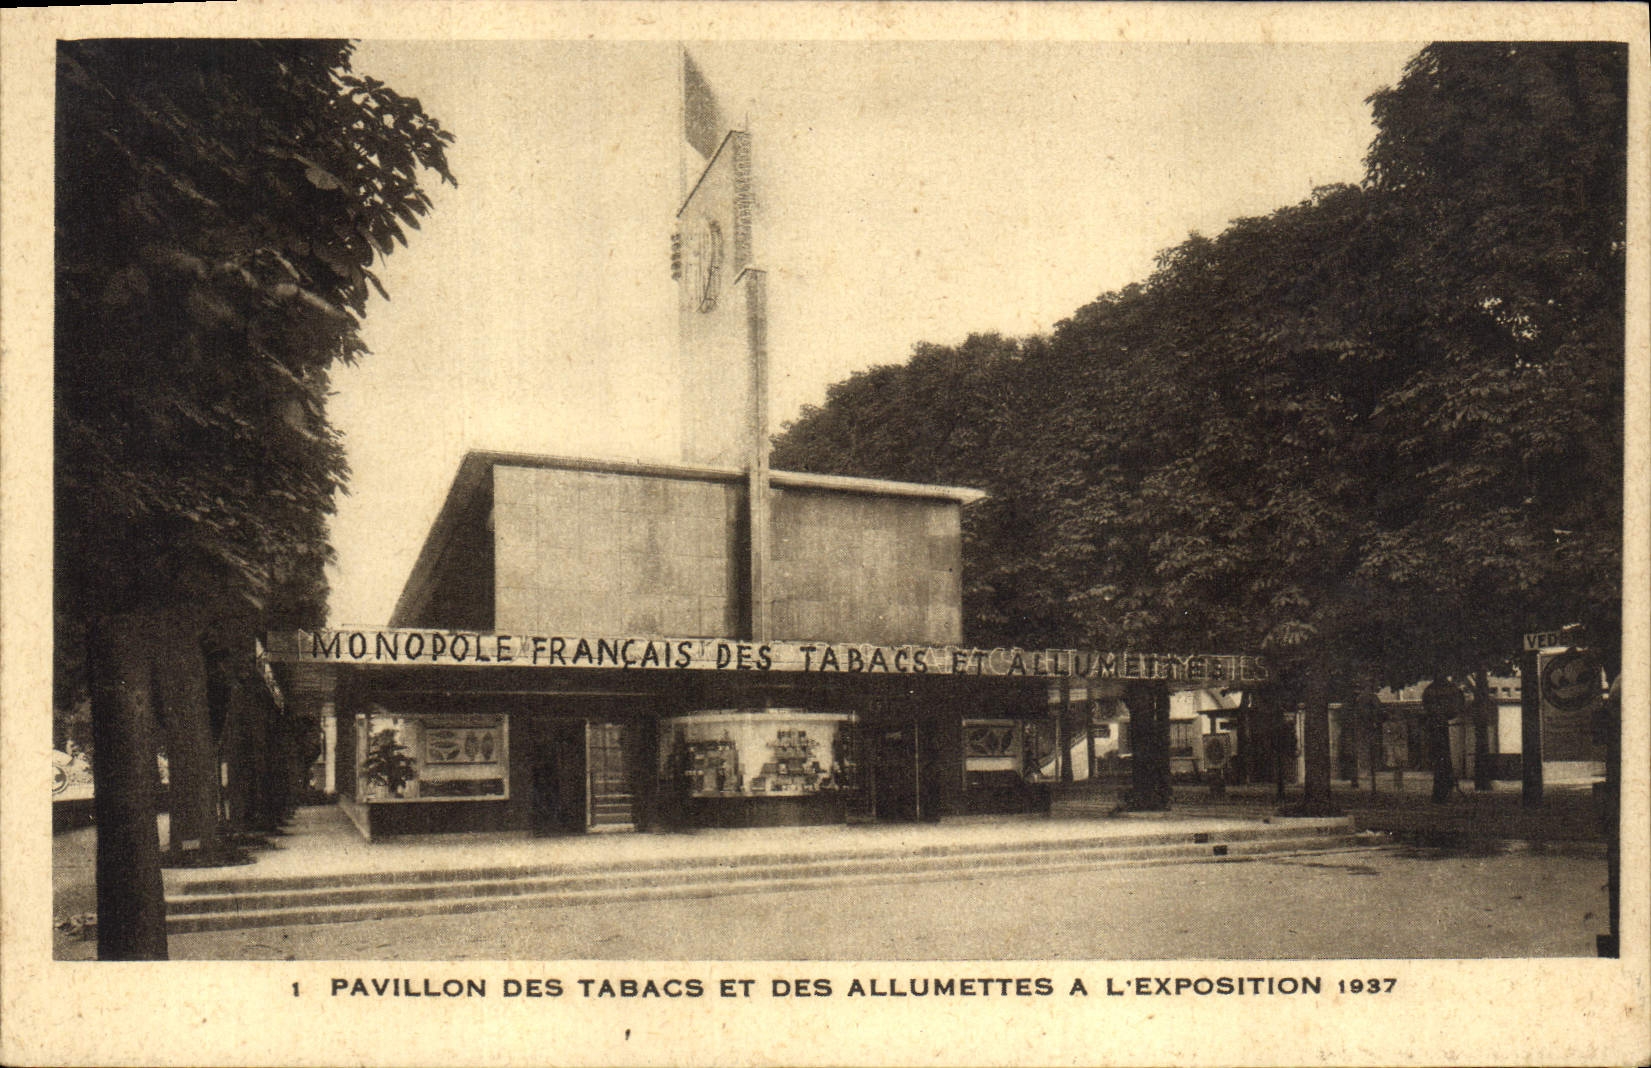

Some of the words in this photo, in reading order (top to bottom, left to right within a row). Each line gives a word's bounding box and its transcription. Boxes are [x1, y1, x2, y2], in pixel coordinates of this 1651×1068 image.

[312, 631, 513, 662] MONOPOLE
[531, 637, 693, 669] FRANÇAIS
[716, 643, 772, 670] DES
[800, 646, 928, 674] TABACS
[952, 650, 988, 676] ET
[1007, 651, 1224, 680] ALLUMETTES
